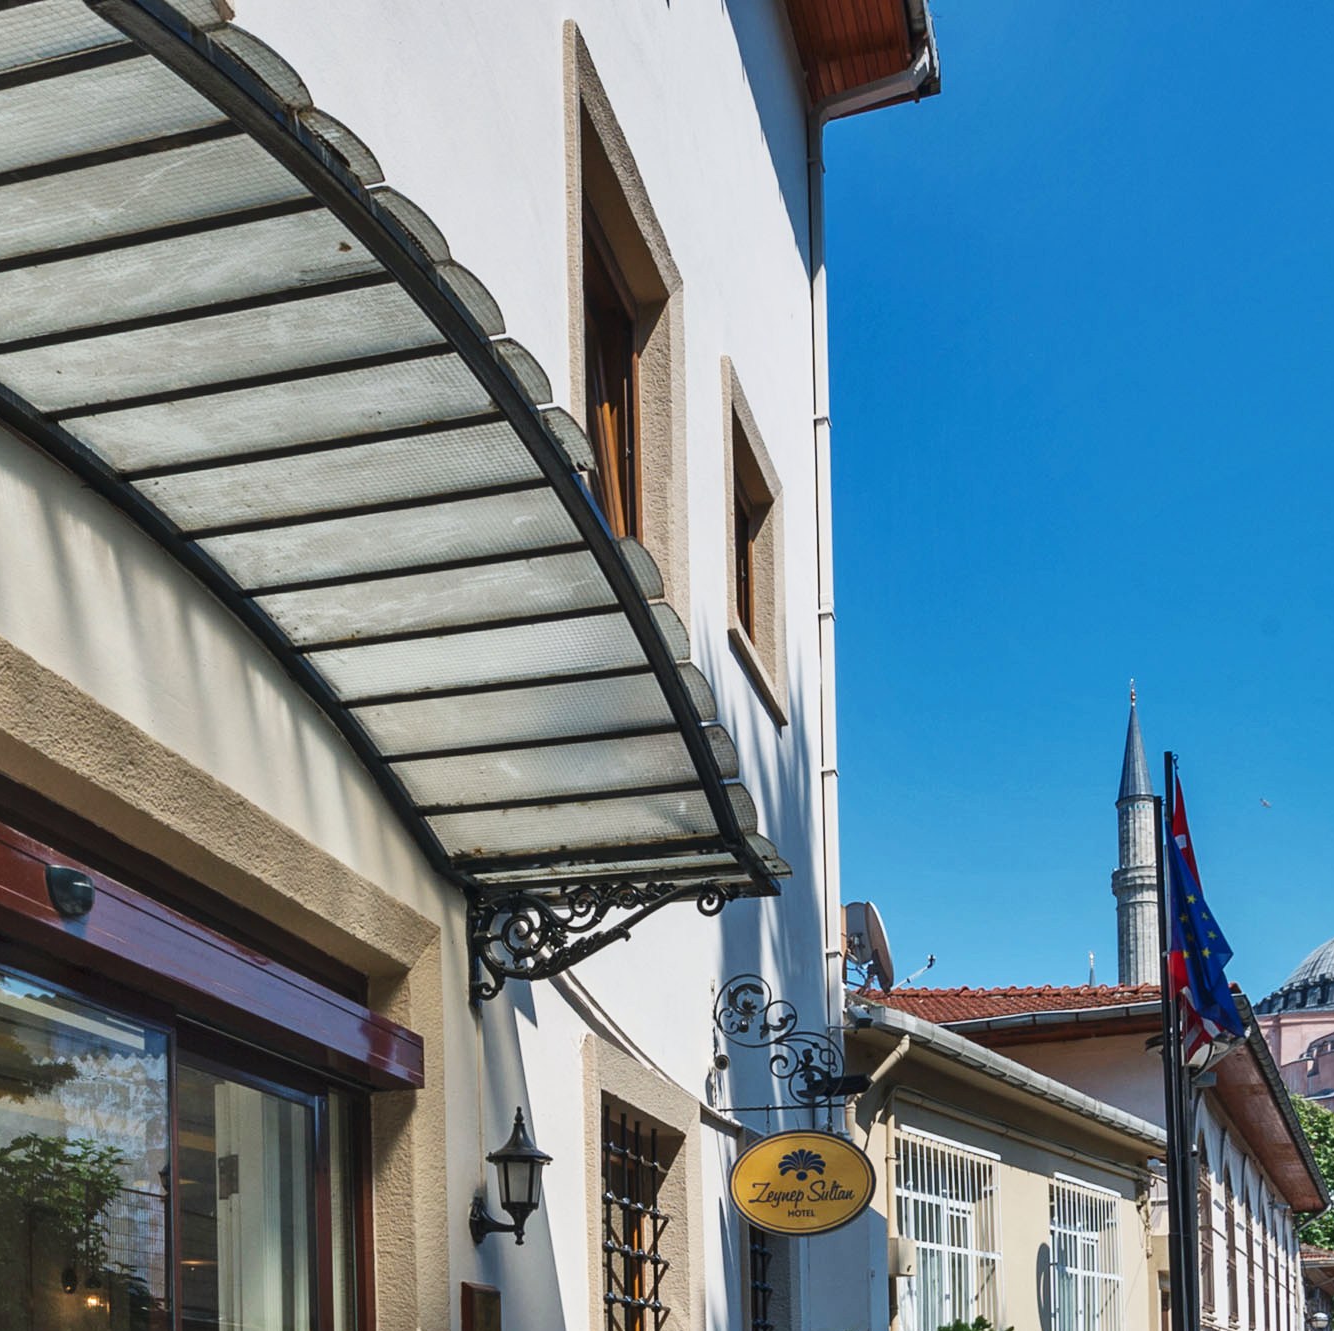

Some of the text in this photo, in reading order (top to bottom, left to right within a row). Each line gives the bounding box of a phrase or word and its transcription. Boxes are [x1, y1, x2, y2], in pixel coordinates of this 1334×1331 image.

[749, 1180, 855, 1208] Zeynep Sultan
[787, 1209, 815, 1217] HOTEL
